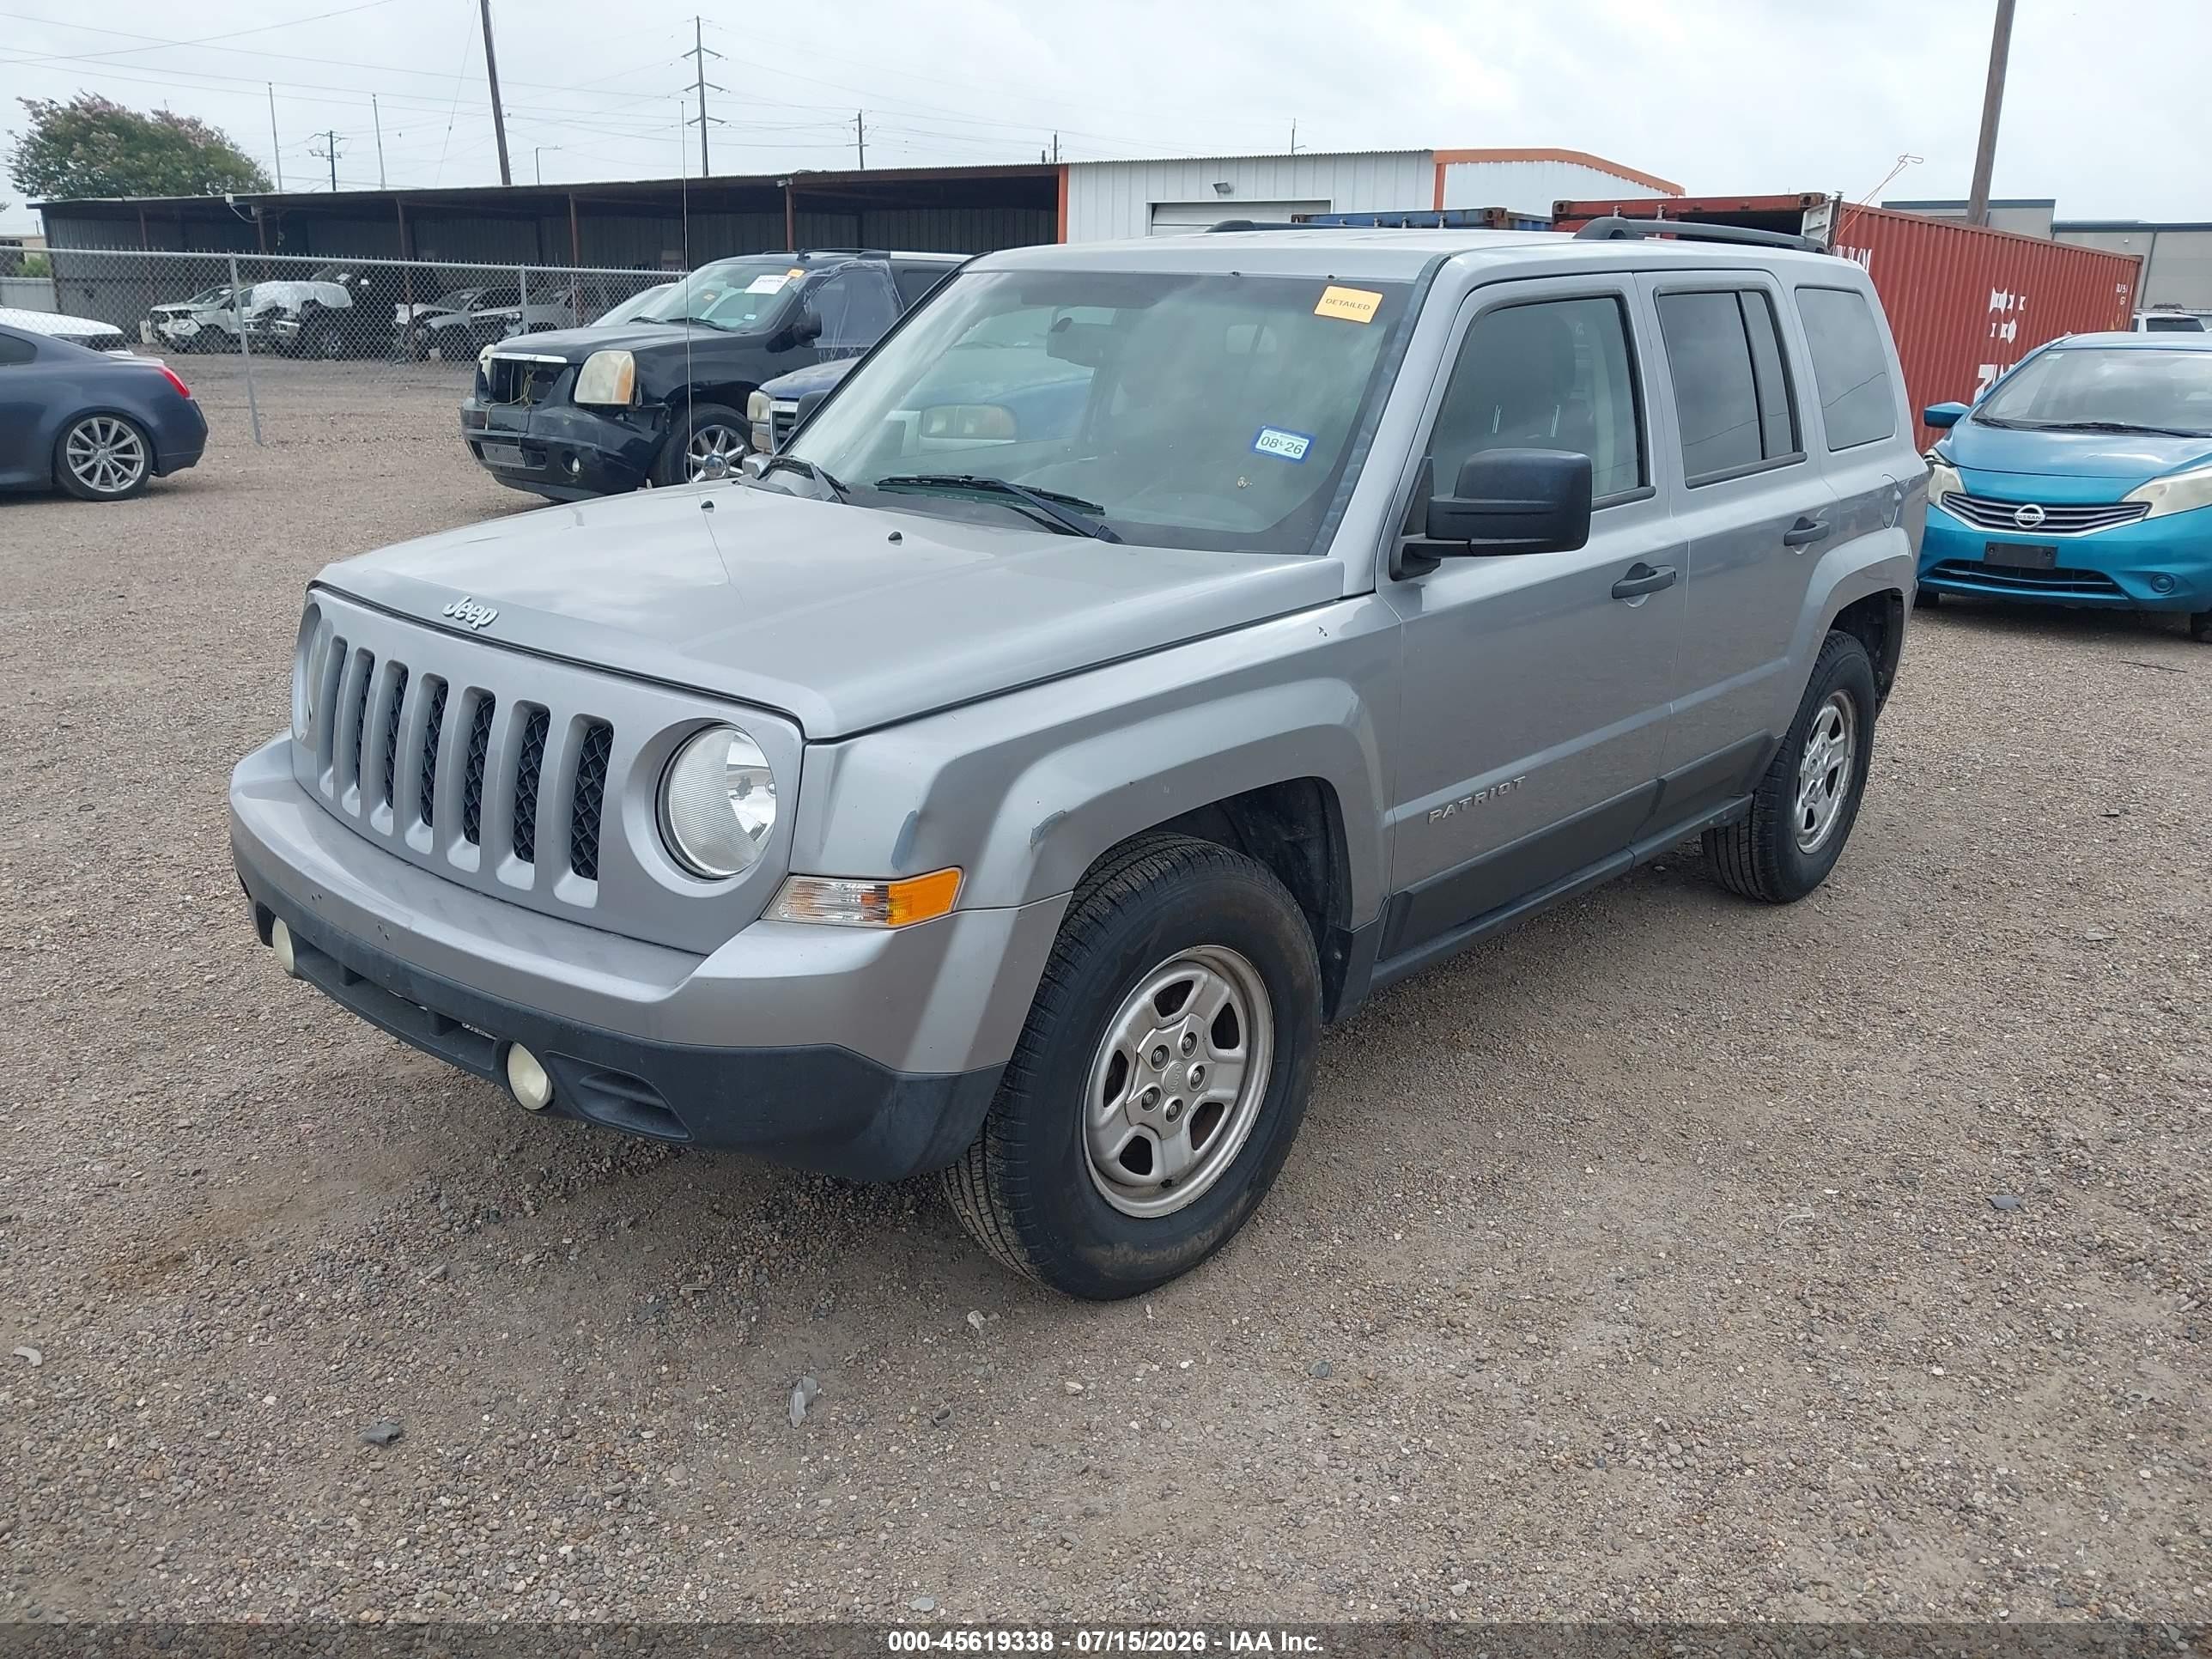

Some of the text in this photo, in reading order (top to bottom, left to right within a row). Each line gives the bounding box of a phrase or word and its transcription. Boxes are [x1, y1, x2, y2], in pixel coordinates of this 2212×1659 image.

[1325, 298, 1371, 311] DETAILED
[1261, 436, 1279, 448] 08
[1284, 441, 1304, 454] 26
[442, 595, 499, 630] Jeep
[1427, 775, 1527, 825] PATRIOT
